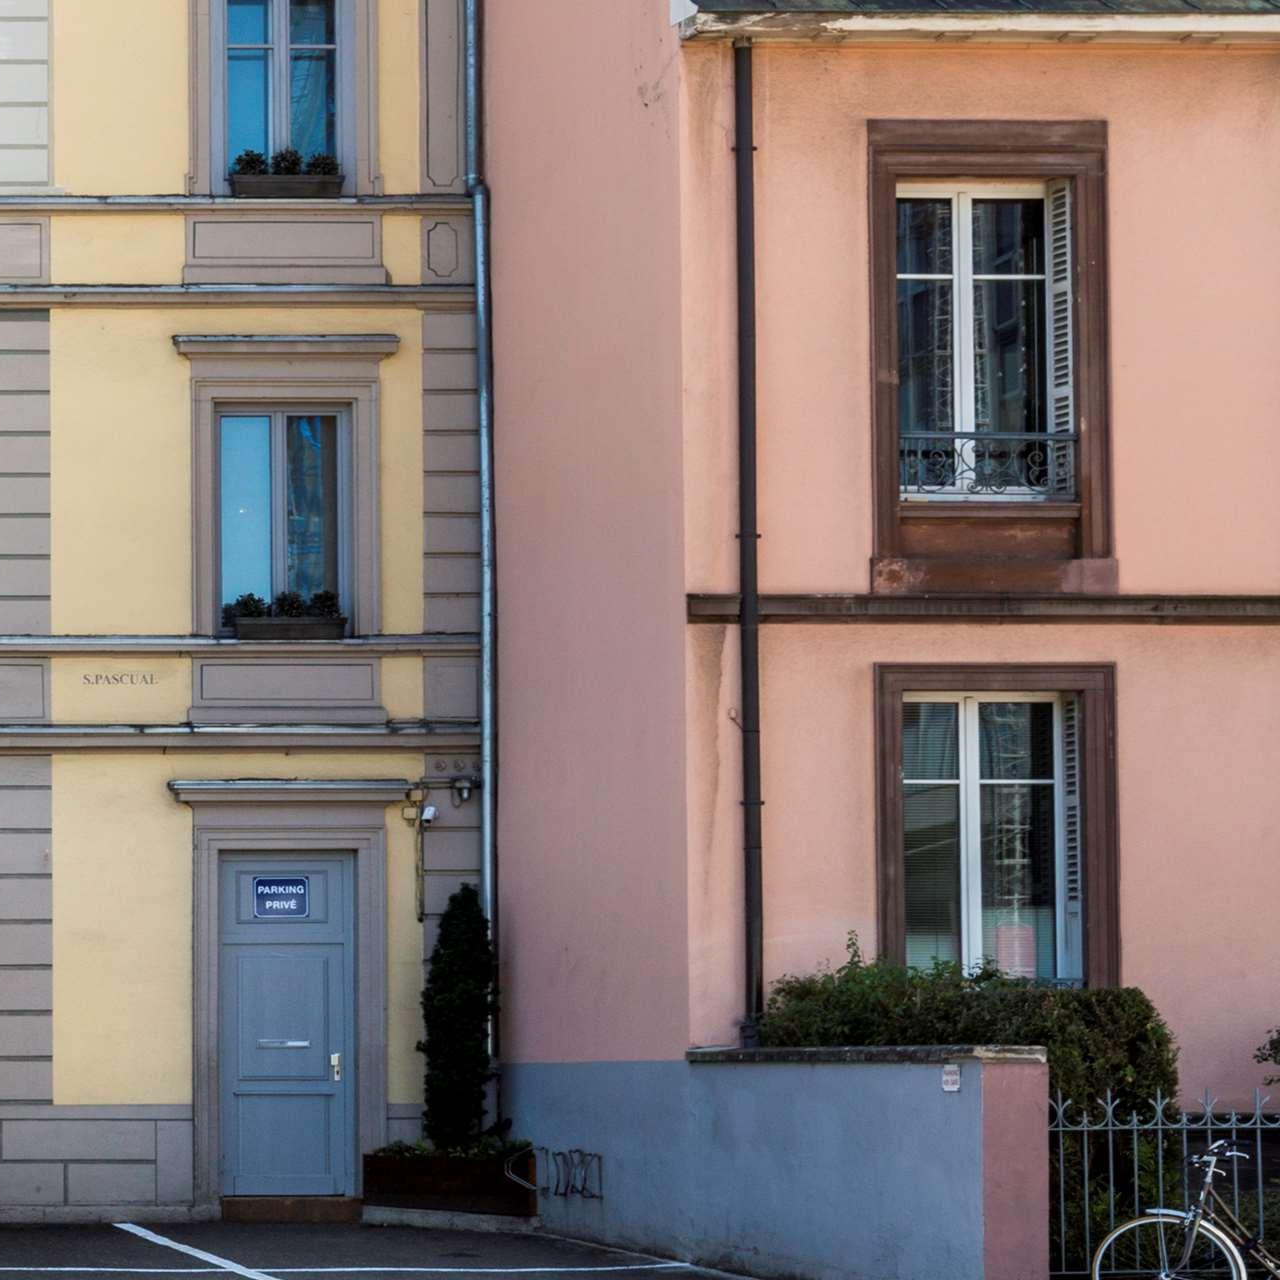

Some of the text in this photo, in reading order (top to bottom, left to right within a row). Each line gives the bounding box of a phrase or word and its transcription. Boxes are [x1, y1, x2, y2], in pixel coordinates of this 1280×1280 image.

[82, 673, 158, 686] S.PASCUAL
[257, 885, 304, 895] PARKING
[265, 898, 297, 910] PRIVÉ
